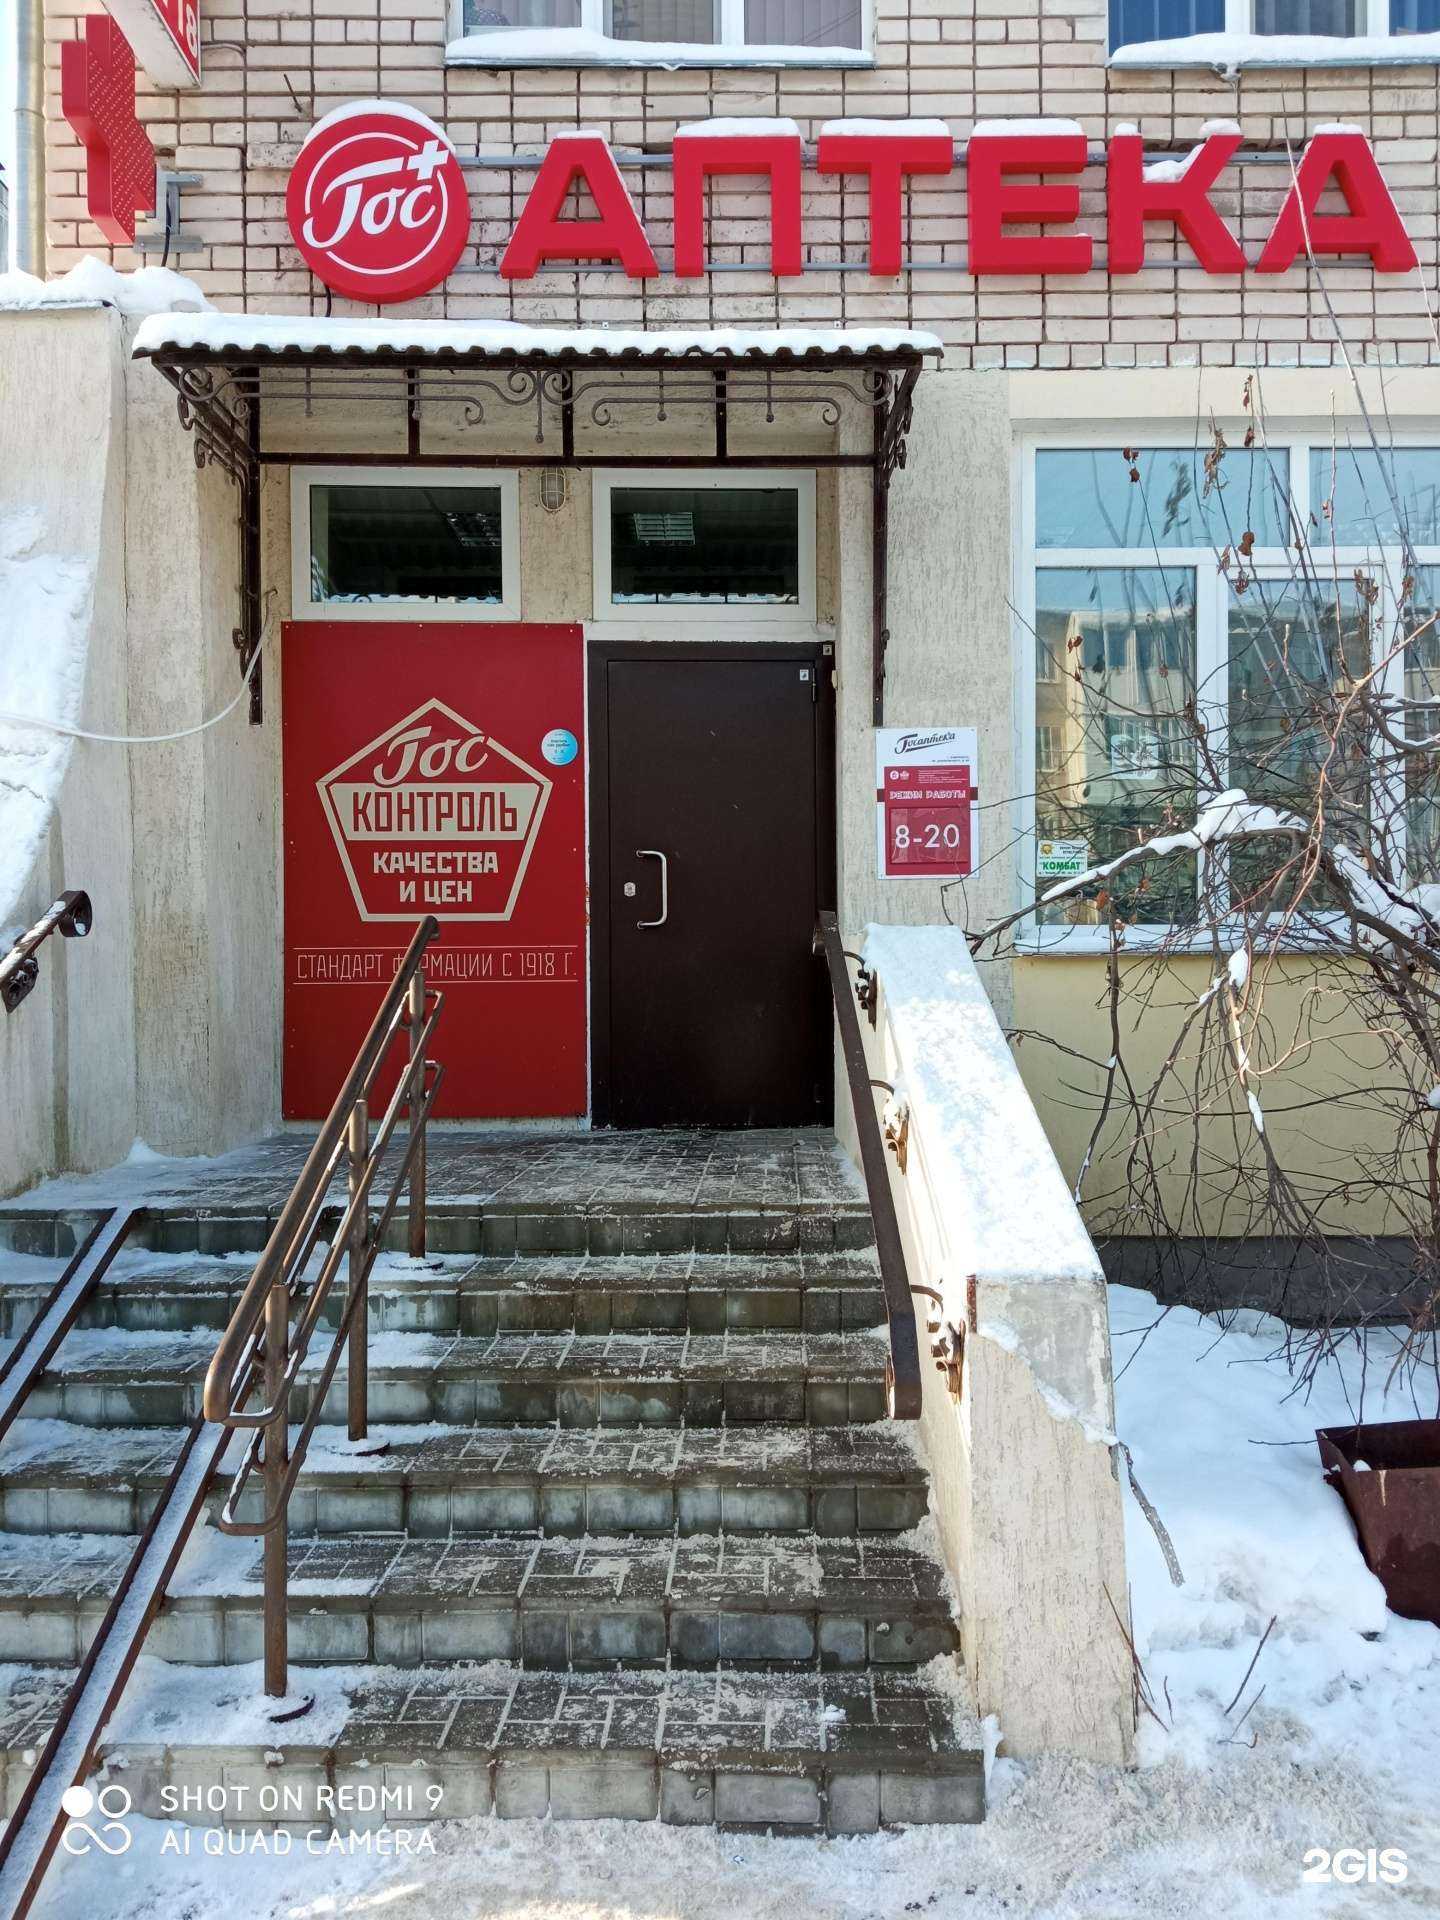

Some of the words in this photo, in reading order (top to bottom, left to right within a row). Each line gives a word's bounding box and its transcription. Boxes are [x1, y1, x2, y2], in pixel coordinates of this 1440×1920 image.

[500, 133, 1418, 279] АПТЕКА
[373, 726, 488, 785] Гос
[926, 789, 966, 799] РАБОТЫ
[353, 791, 518, 832] КОНТРОЛЬ
[895, 823, 960, 848] 8-20
[373, 852, 499, 874] КАЧЕСТВА
[399, 880, 416, 903] И
[424, 880, 473, 905] ЦЕН
[297, 954, 384, 981] СТАНДАРТ
[393, 952, 493, 979] ФРМАЦИИ
[502, 953, 512, 976] С
[519, 952, 555, 976] 1918
